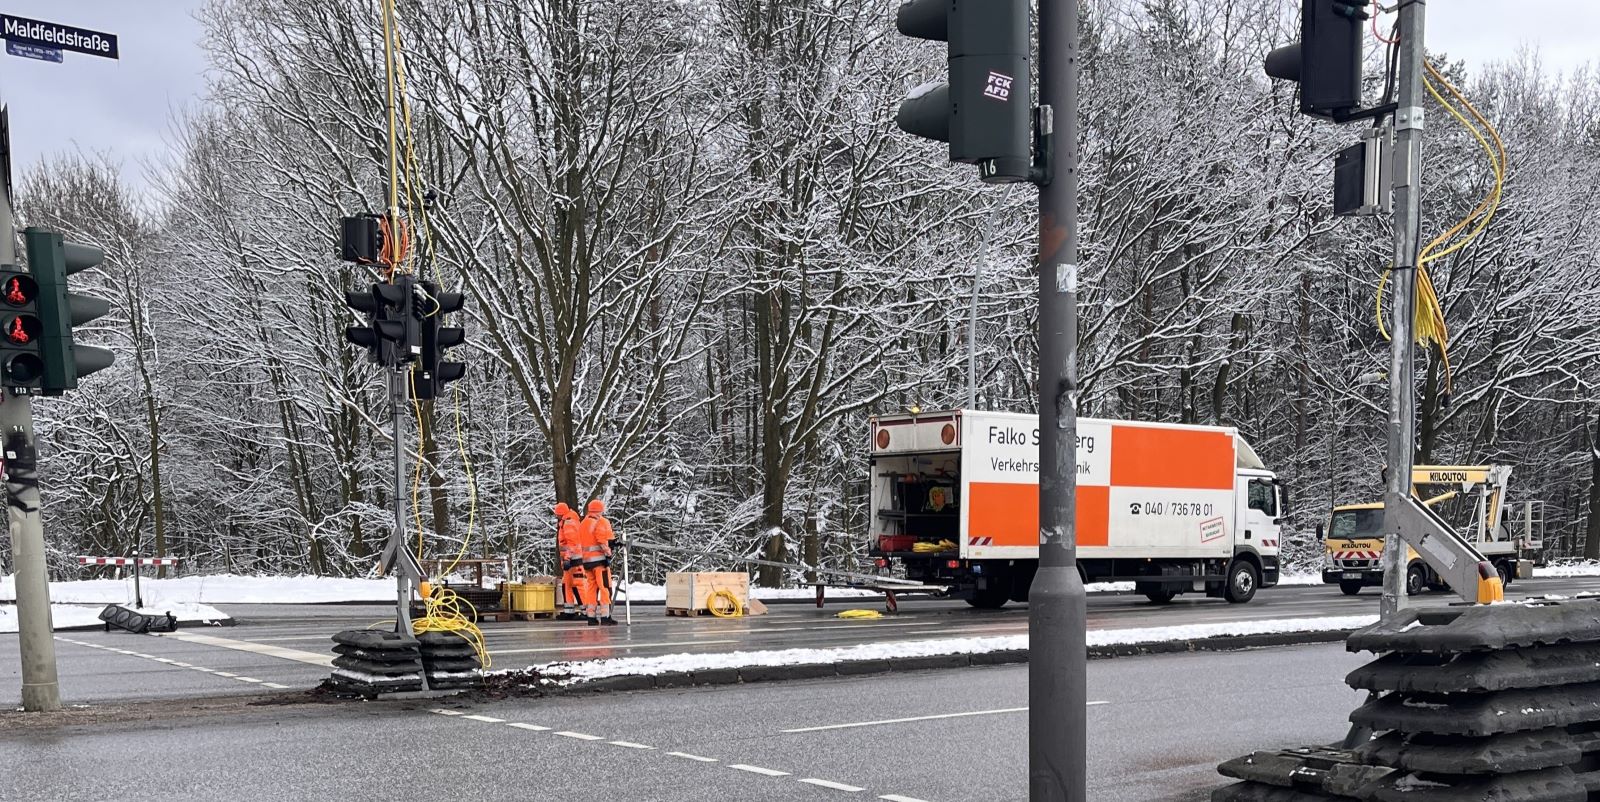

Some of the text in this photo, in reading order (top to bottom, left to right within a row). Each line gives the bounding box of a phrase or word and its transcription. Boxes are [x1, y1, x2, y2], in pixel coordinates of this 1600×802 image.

[4, 18, 110, 52] Maldfeldstraße
[987, 75, 1012, 89] FCK
[985, 86, 1009, 97] AFD
[989, 426, 1026, 446] Falko
[1145, 502, 1213, 516] 040 / 736 78 01
